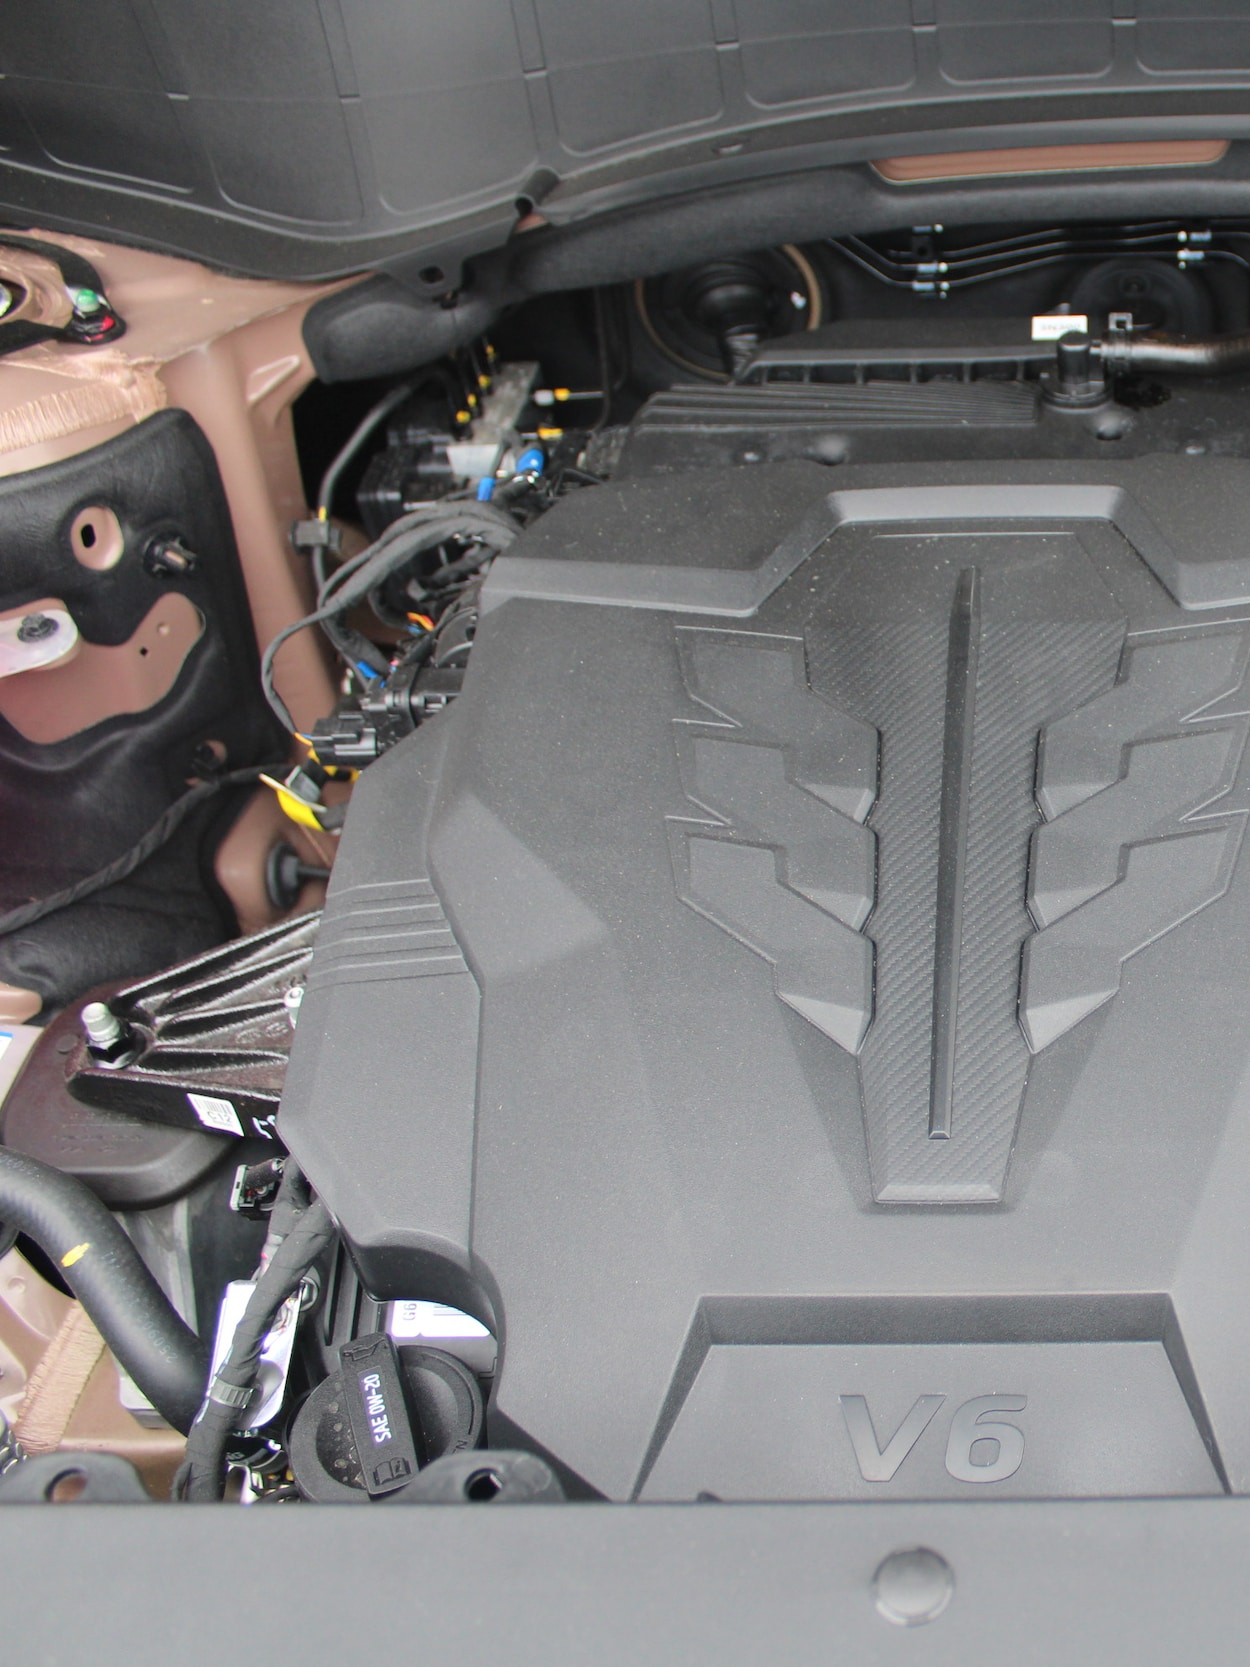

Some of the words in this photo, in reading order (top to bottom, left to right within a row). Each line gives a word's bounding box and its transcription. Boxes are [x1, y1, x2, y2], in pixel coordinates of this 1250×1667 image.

[363, 1373, 386, 1415] 0W-20
[372, 1414, 392, 1443] SAE
[839, 1393, 1028, 1484] V6
